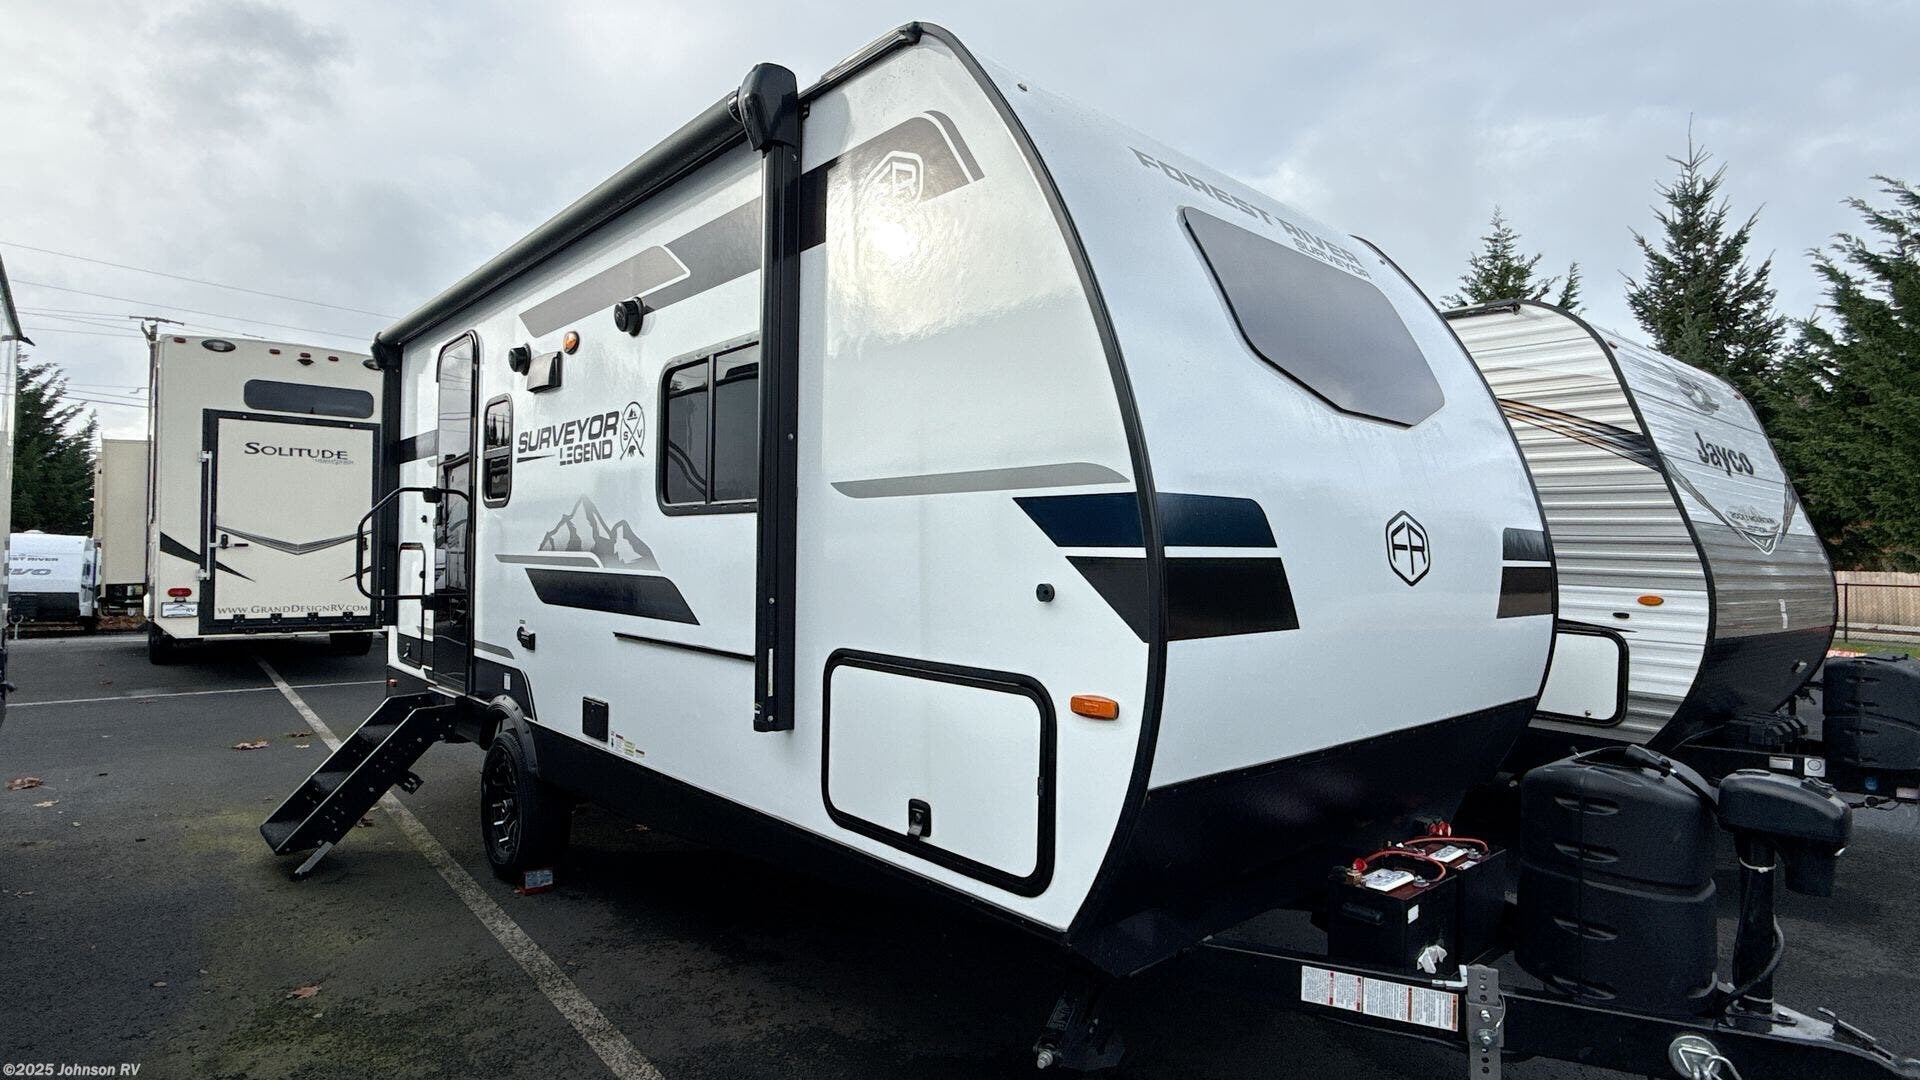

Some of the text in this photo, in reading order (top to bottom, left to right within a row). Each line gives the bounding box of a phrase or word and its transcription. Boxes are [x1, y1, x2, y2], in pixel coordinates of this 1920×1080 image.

[1128, 146, 1365, 269] FOREST RIVER
[1292, 238, 1372, 280] SURVEYOR
[244, 442, 348, 460] SOLITUDE
[518, 410, 620, 454] SURVEYOR
[559, 439, 613, 466] LEGEND
[1694, 430, 1754, 478] Jayco
